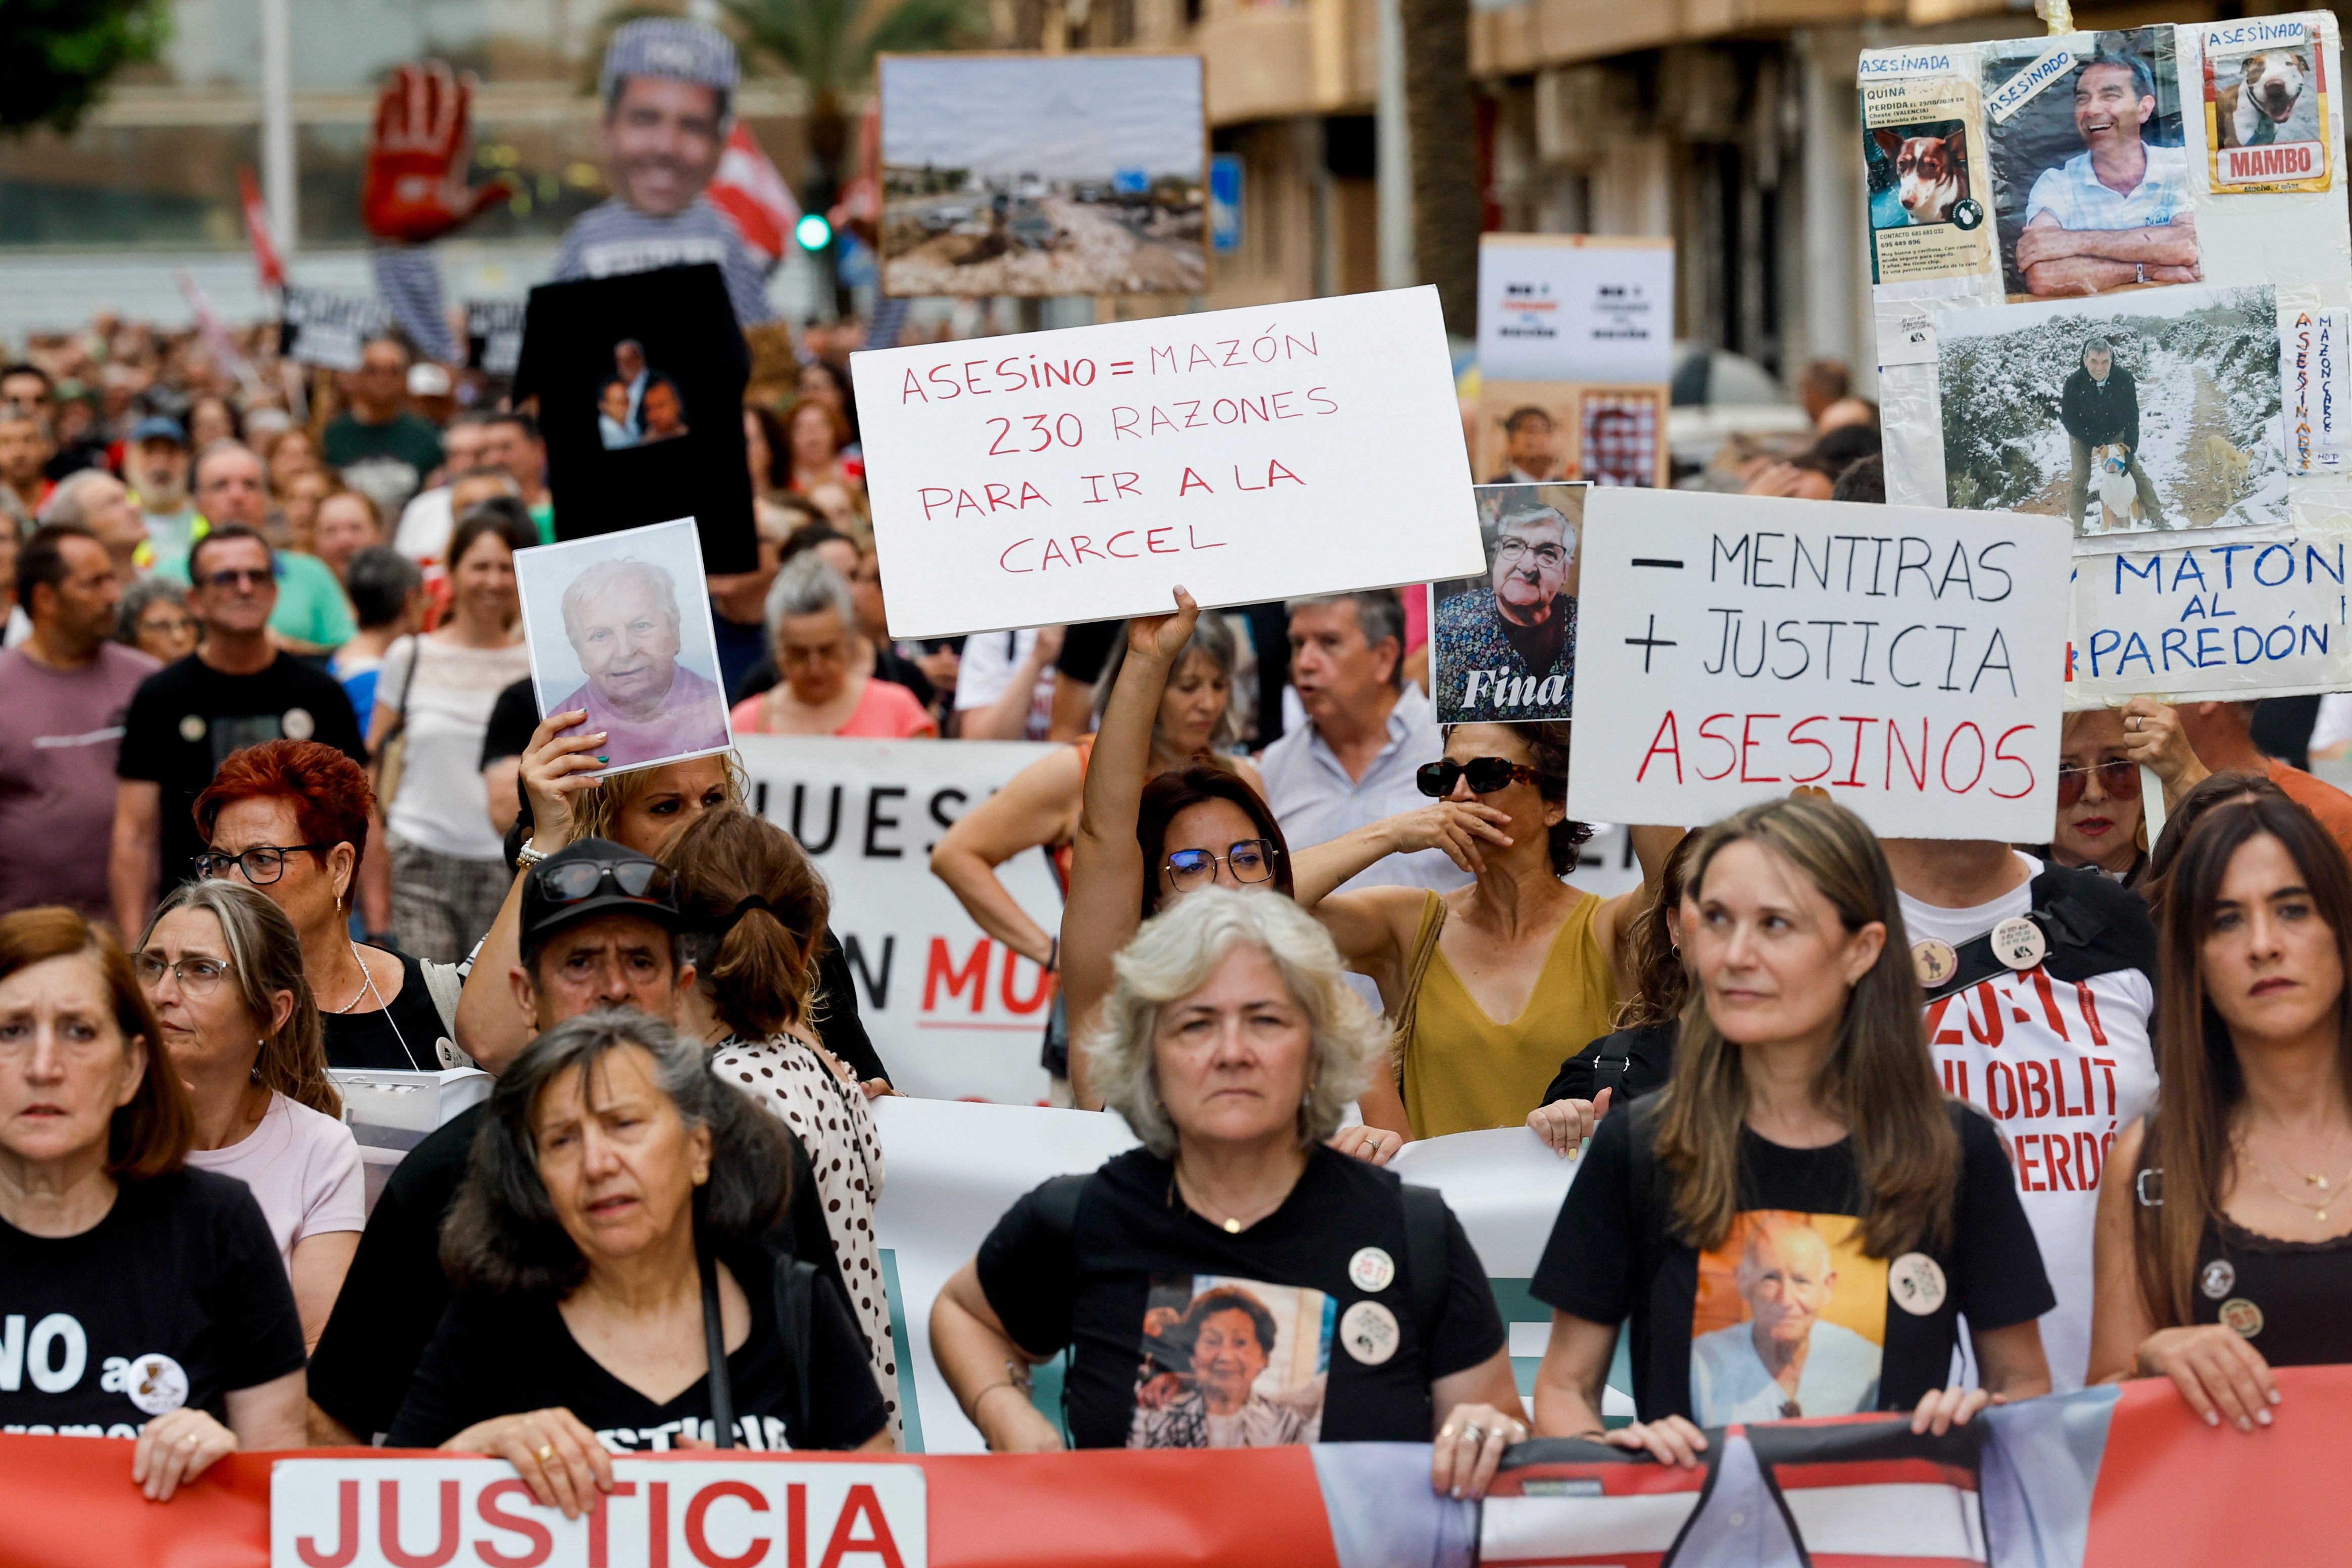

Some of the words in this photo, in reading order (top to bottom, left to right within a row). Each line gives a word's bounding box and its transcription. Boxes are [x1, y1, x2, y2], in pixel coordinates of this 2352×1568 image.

[1860, 55, 1950, 73] ASESINADA
[2209, 22, 2304, 46] ASESINADO
[1867, 87, 1906, 100] QUINA
[1869, 102, 1908, 112] PERDIDA
[1893, 109, 1929, 117] (VALENCIA)
[1989, 52, 2069, 115] ASESINADO
[2230, 147, 2311, 178] MAMBO
[903, 354, 1096, 405] ASESINO
[1151, 323, 1318, 377] MAZÓN
[986, 412, 1083, 456] 230
[1113, 386, 1338, 440] RAZONES
[917, 481, 1051, 521] PARA
[1081, 471, 1143, 505] IR
[1179, 467, 1214, 497] A
[1236, 459, 1306, 491] LA
[1000, 524, 1228, 573] CARCEL
[1710, 532, 2017, 602] MENTIRAS
[2115, 537, 2344, 595] MATÓN
[2180, 592, 2237, 622] AL
[1703, 608, 2017, 698] JUSTICIA
[2090, 611, 2327, 677] PAREDÓN
[1460, 666, 1567, 708] Fina
[1635, 710, 2035, 799] ASESINOS
[756, 783, 998, 856] UES
[1986, 1057, 2117, 1120] OBLIT
[295, 1480, 906, 1568] JUSTICIA
